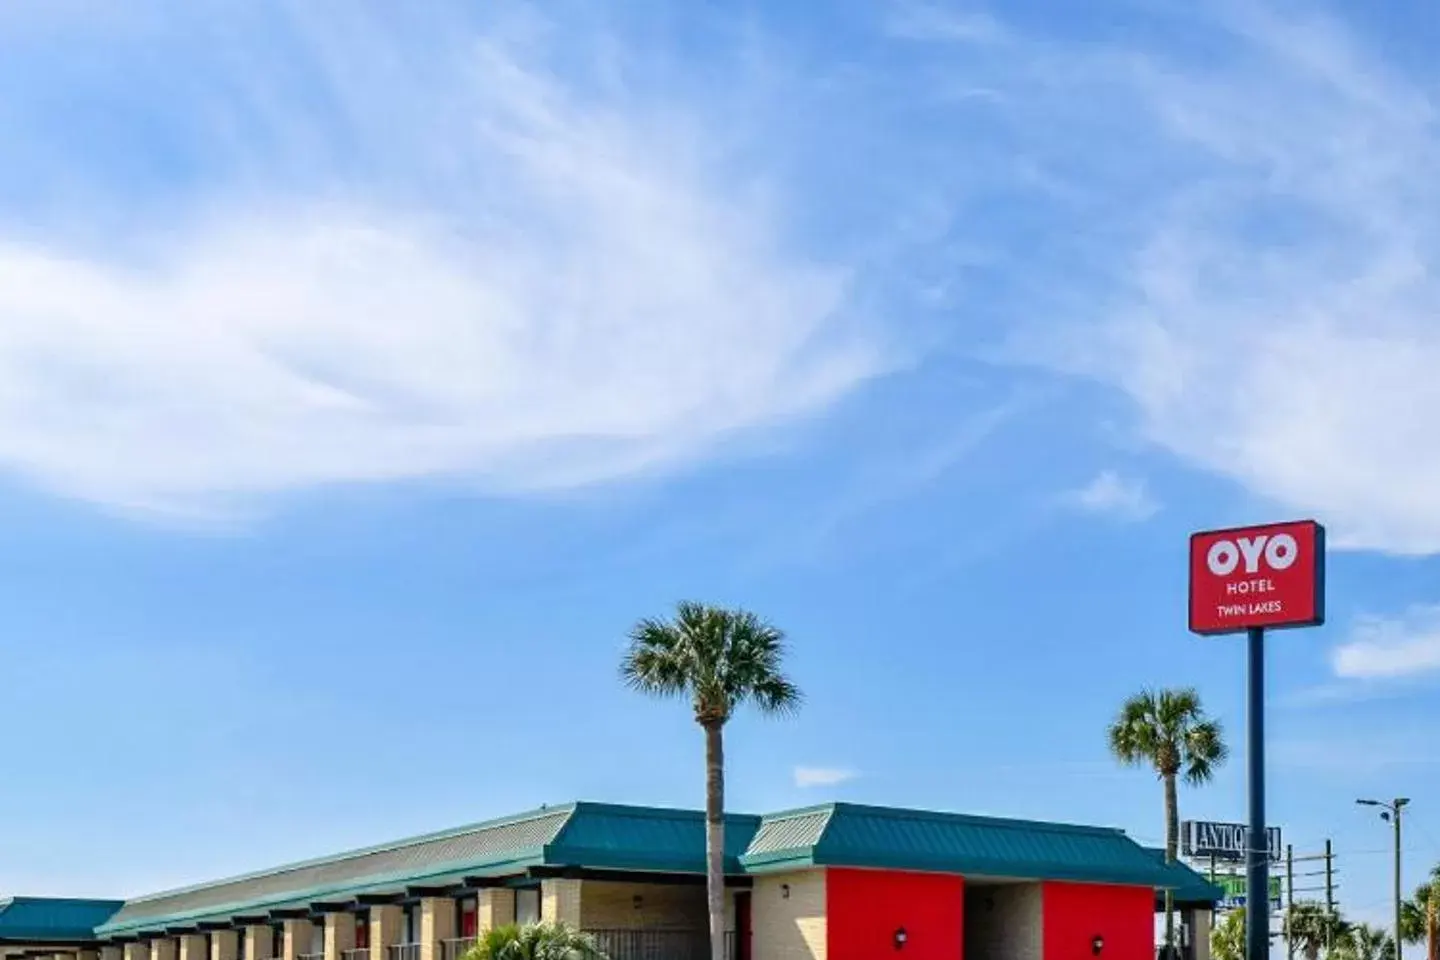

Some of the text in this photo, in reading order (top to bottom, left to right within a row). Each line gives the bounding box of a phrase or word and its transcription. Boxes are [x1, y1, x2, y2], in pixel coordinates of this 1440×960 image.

[1207, 533, 1297, 576] OYO
[1226, 579, 1276, 595] HOTEL
[1216, 600, 1282, 618] TWIN LAKES
[1199, 822, 1273, 857] ANTIQS
